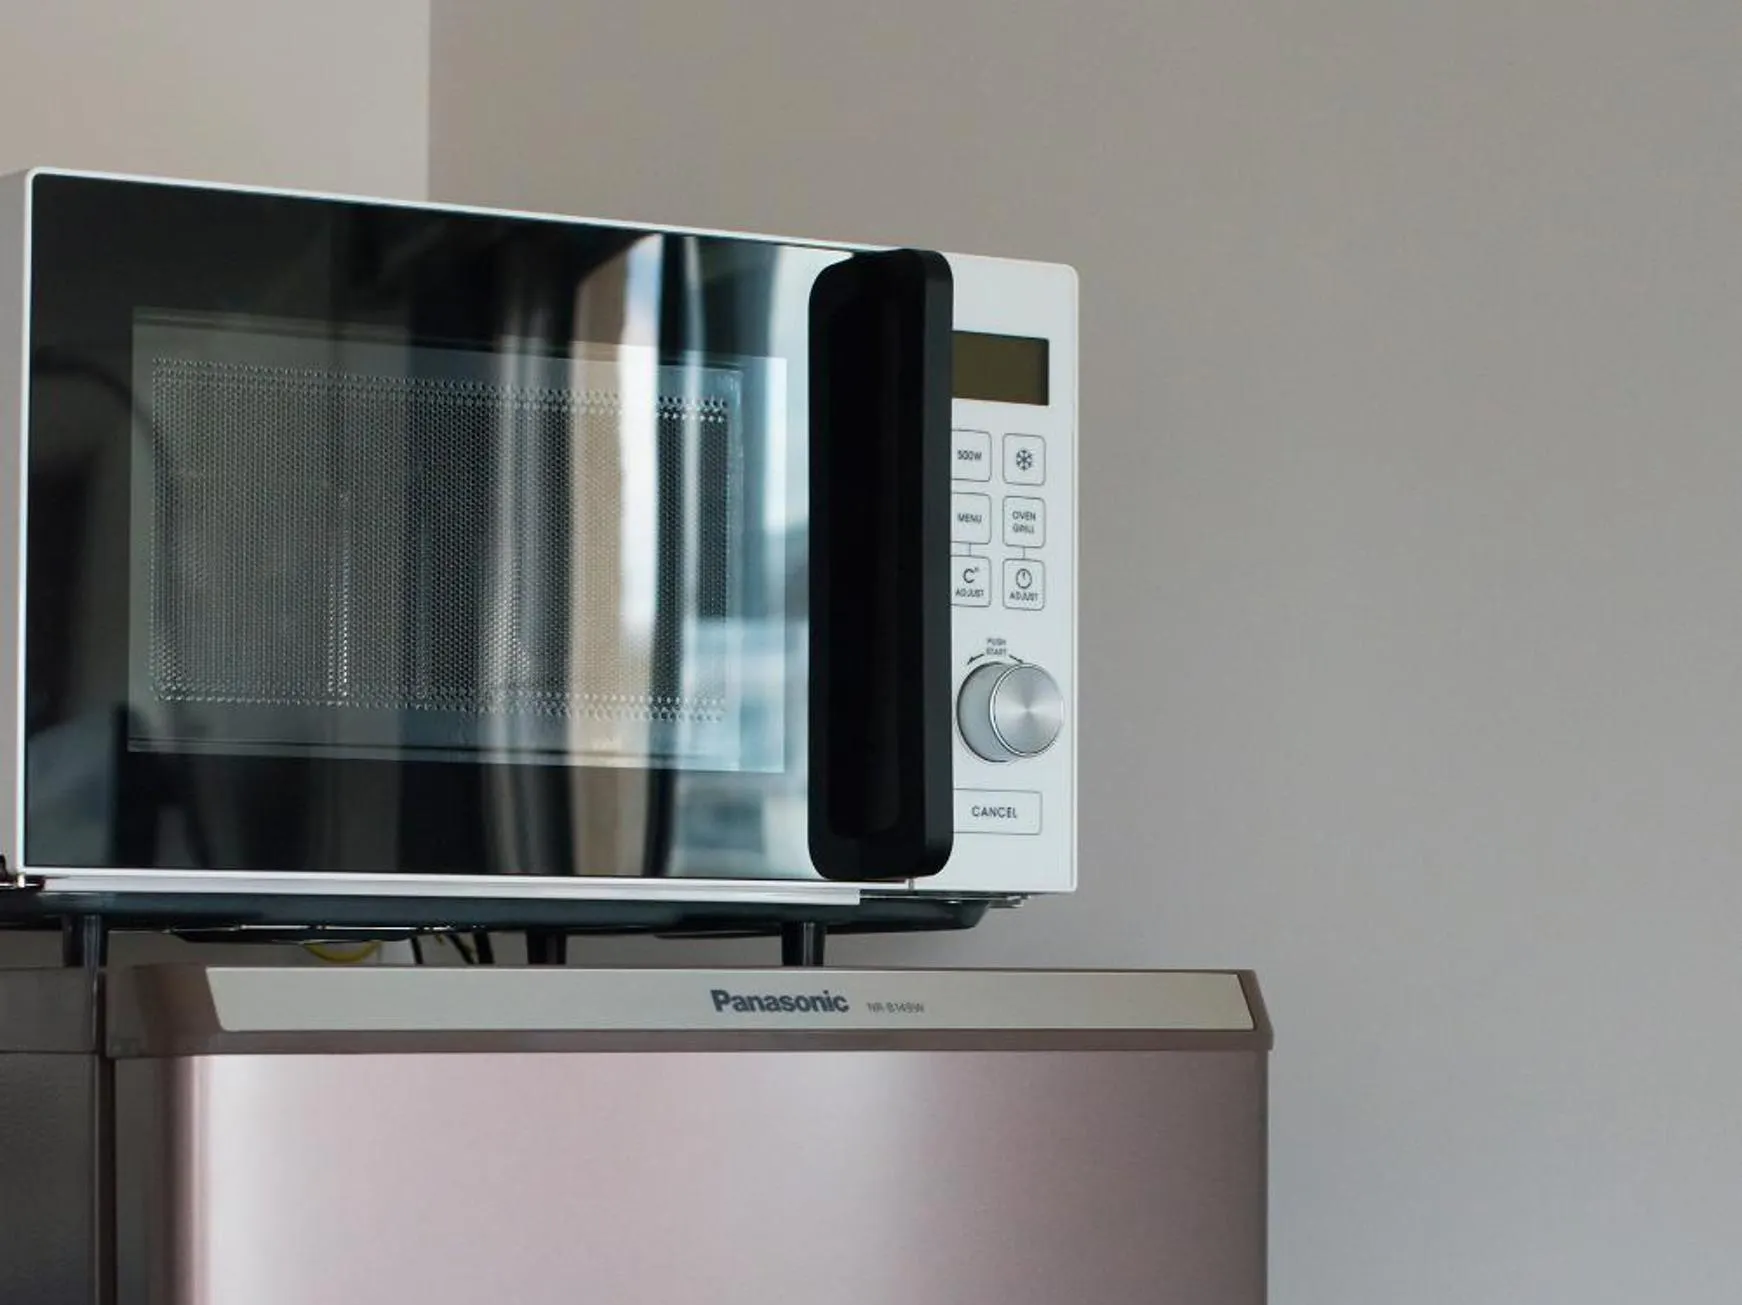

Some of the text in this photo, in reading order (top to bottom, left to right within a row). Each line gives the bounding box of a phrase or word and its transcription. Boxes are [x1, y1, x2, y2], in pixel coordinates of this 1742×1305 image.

[957, 512, 982, 524] MENU
[1012, 511, 1036, 522] OVEN
[1012, 523, 1035, 534] GRILL
[955, 588, 984, 598] ADJUST
[1009, 591, 1038, 602] ADJUST
[971, 805, 1017, 819] CANCEL
[711, 989, 849, 1013] Panasonic
